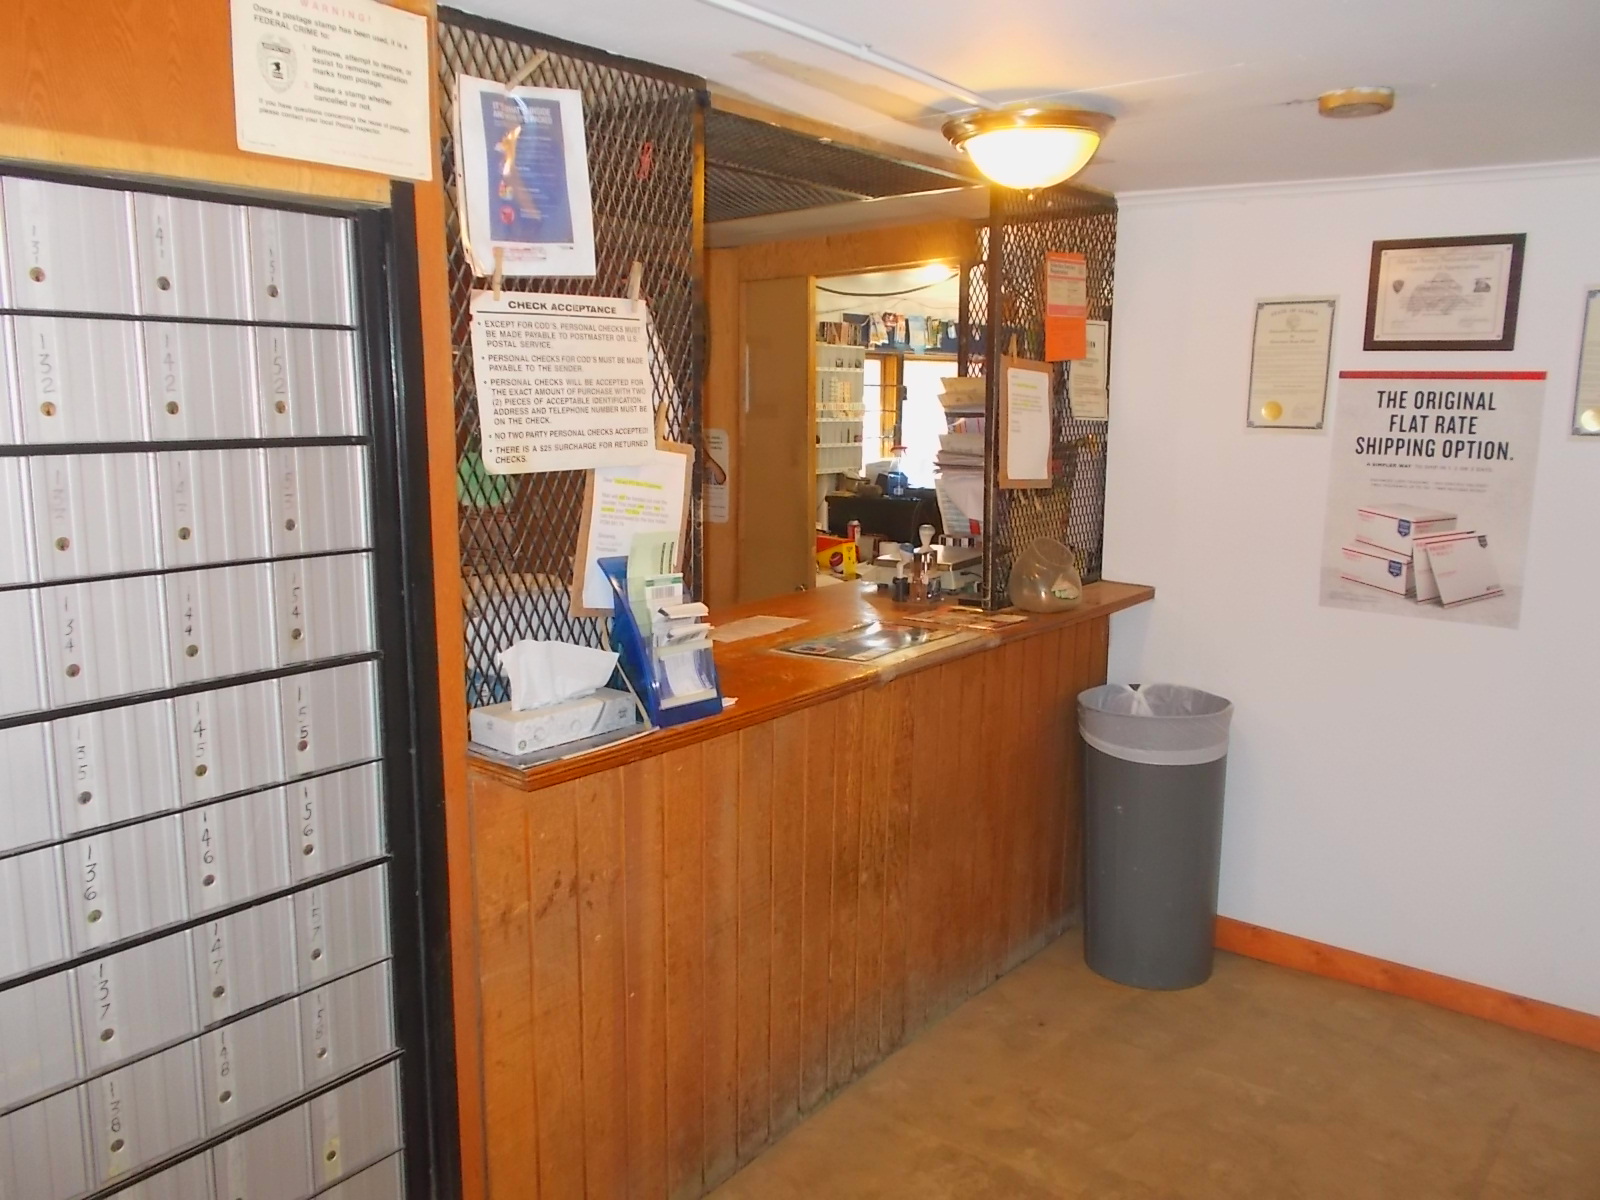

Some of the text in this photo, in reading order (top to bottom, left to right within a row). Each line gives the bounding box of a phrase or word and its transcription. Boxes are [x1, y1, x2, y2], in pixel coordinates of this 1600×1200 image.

[253, 3, 273, 15] Once
[283, 12, 312, 25] postage
[314, 20, 337, 32] stamp
[338, 25, 351, 34] has
[354, 29, 370, 39] been
[253, 14, 290, 30] FEDERAL
[293, 24, 318, 37] CRIME
[345, 54, 371, 65] attempt
[312, 58, 334, 67] assist
[345, 64, 370, 74] remove
[371, 70, 408, 84] cancellation
[312, 68, 334, 77] marks
[337, 73, 353, 81] from
[313, 82, 335, 94] Reuse
[345, 90, 366, 101] stamp
[368, 95, 392, 105] whether
[314, 95, 347, 106] cancelled
[281, 112, 303, 121] contact
[293, 106, 323, 116] questions
[508, 301, 617, 314] CHECK ACCEPTANCE
[484, 320, 515, 328] EXCEPT
[560, 323, 596, 332] PERSONAL
[598, 324, 624, 333] CHECKS
[485, 330, 497, 338] BE
[500, 330, 522, 338] MADE
[524, 331, 556, 339] PAYABLE
[570, 332, 614, 341] POSTMASTER
[486, 340, 517, 348] POSTAL
[39, 333, 56, 394] 132
[163, 334, 177, 392] 142
[273, 338, 286, 394] 152
[488, 354, 530, 362] PERSONAL
[531, 355, 560, 363] CHECKS
[561, 355, 575, 363] FOR
[598, 356, 616, 364] MUST
[489, 364, 522, 372] PAYABLE
[525, 364, 535, 372] TO
[490, 378, 532, 386] PERSONAL
[534, 378, 564, 386] CHECKS
[492, 388, 507, 396] THE
[508, 388, 532, 396] EXACT
[492, 398, 502, 407] (2)
[504, 398, 532, 406] PIECES
[546, 397, 590, 405] ACCEPTABLE
[493, 407, 529, 416] ADDRESS
[549, 406, 589, 414] TELEPHONE
[1377, 390, 1497, 411] THE ORIGINAL
[494, 417, 506, 425] ON
[508, 417, 523, 425] THE
[1389, 414, 1479, 435] FLAT RATE
[494, 432, 506, 440] NO
[508, 431, 524, 439] TWO
[525, 430, 548, 438] PARTY
[550, 429, 585, 438] PERSONAL
[587, 428, 614, 436] CHECKS
[496, 446, 521, 454] THERE
[523, 445, 530, 453] IS
[540, 444, 552, 452] $25
[554, 442, 597, 451] SURCHARGE
[599, 441, 613, 449] FOR
[615, 440, 649, 448] RETURNED
[1355, 436, 1514, 461] SHIPPING OPTION.
[64, 596, 75, 652] 134
[184, 592, 193, 636] 144
[193, 701, 206, 758] 145
[303, 787, 313, 836] 156
[201, 811, 214, 864] 146
[83, 844, 98, 901] 136
[211, 922, 223, 974] 147
[99, 963, 111, 1019] 137
[219, 1031, 230, 1077] 148
[109, 1081, 121, 1133] 138
